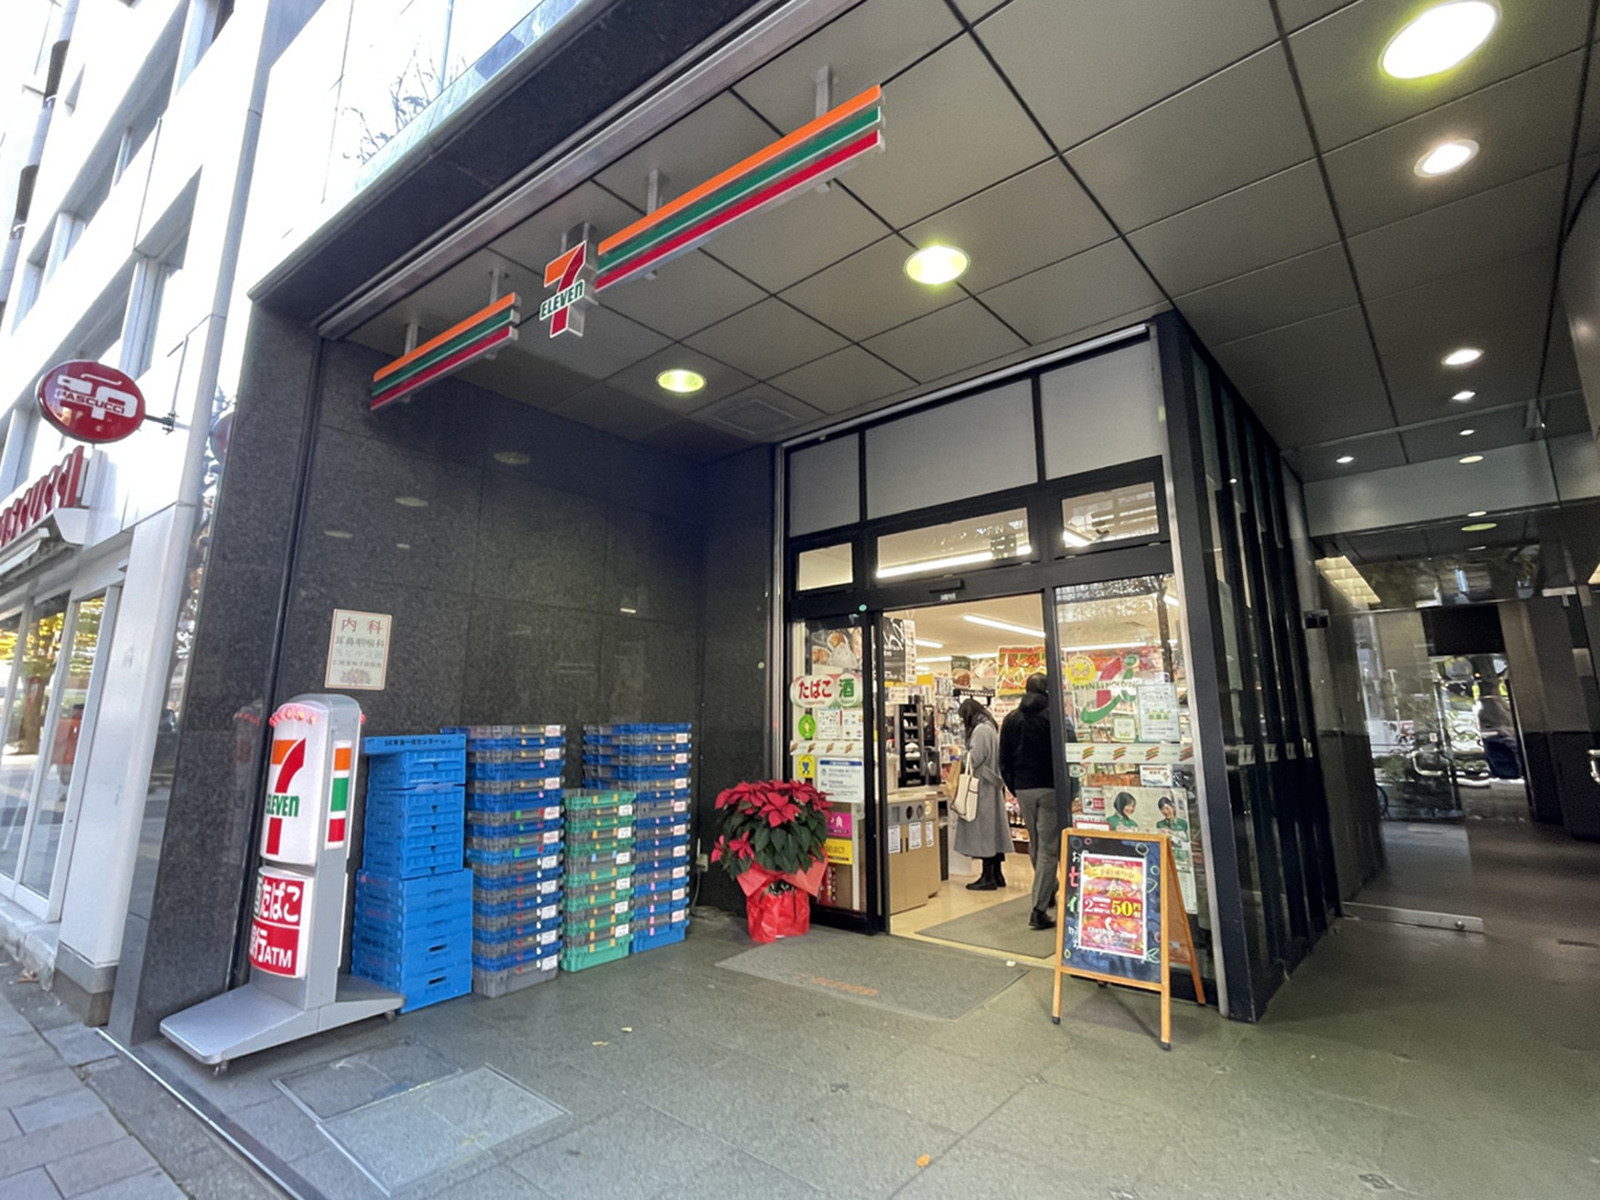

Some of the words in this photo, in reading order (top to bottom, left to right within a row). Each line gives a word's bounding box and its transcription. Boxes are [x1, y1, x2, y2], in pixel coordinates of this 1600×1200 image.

[544, 240, 587, 338] 7
[54, 388, 126, 414] PASCUCCI
[798, 680, 832, 699] たばこ
[838, 678, 855, 698] 酒
[260, 879, 301, 923] たばこ
